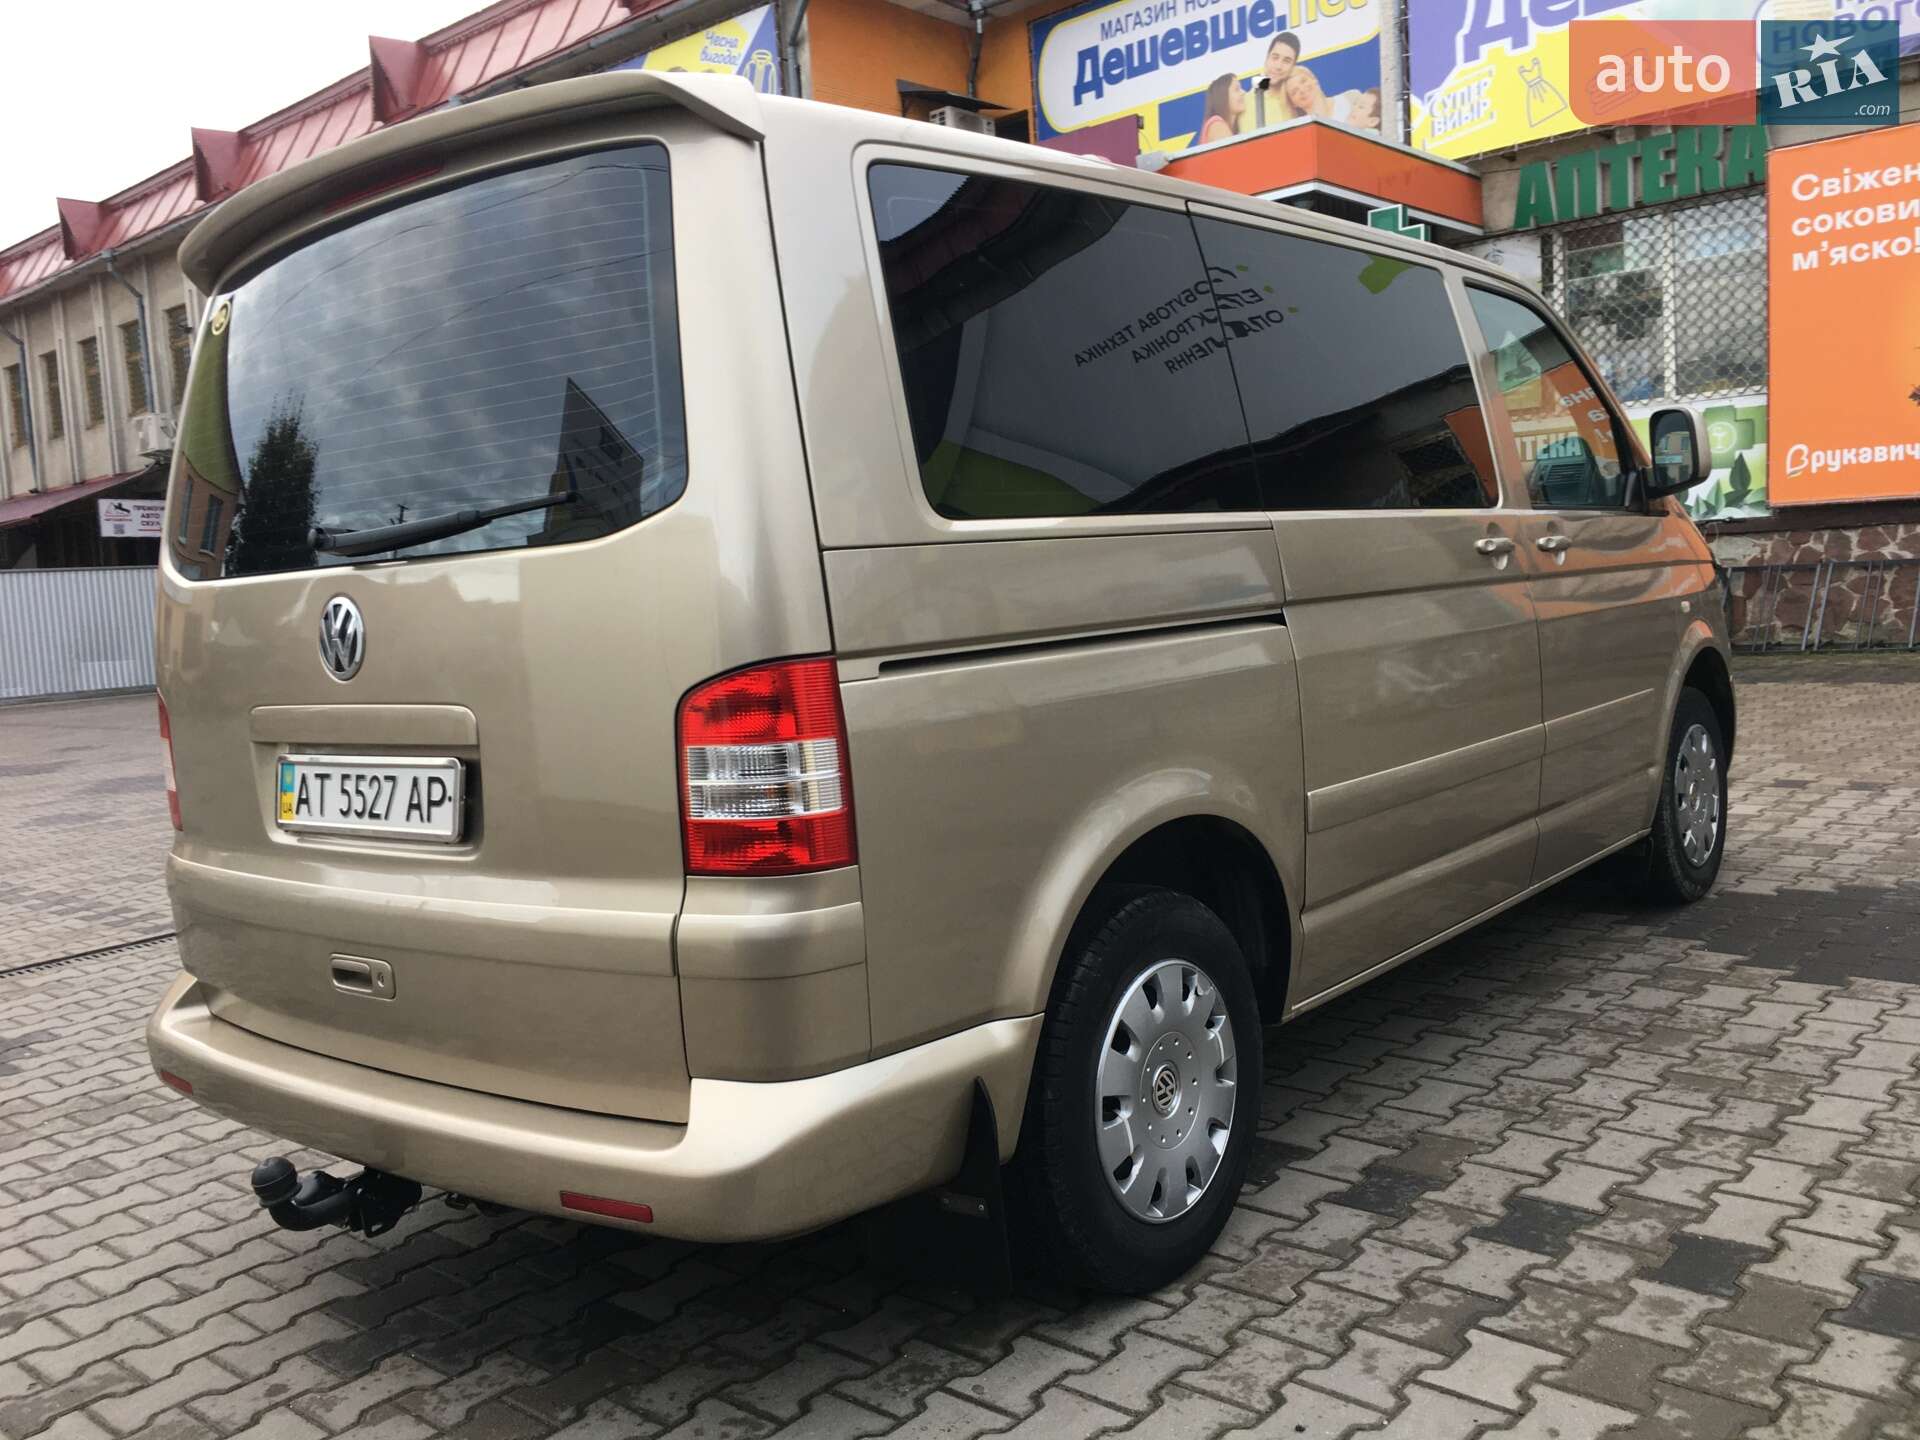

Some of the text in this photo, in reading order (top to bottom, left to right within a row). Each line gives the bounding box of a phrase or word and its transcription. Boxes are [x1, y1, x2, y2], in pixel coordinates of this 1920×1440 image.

[1100, 0, 1177, 41] МАГАЗИН
[1513, 114, 1768, 229] АПТЕКА
[1792, 162, 1920, 201] Свіжен
[1792, 198, 1920, 236] сокови
[295, 772, 332, 817] AT
[339, 773, 398, 821] 5527
